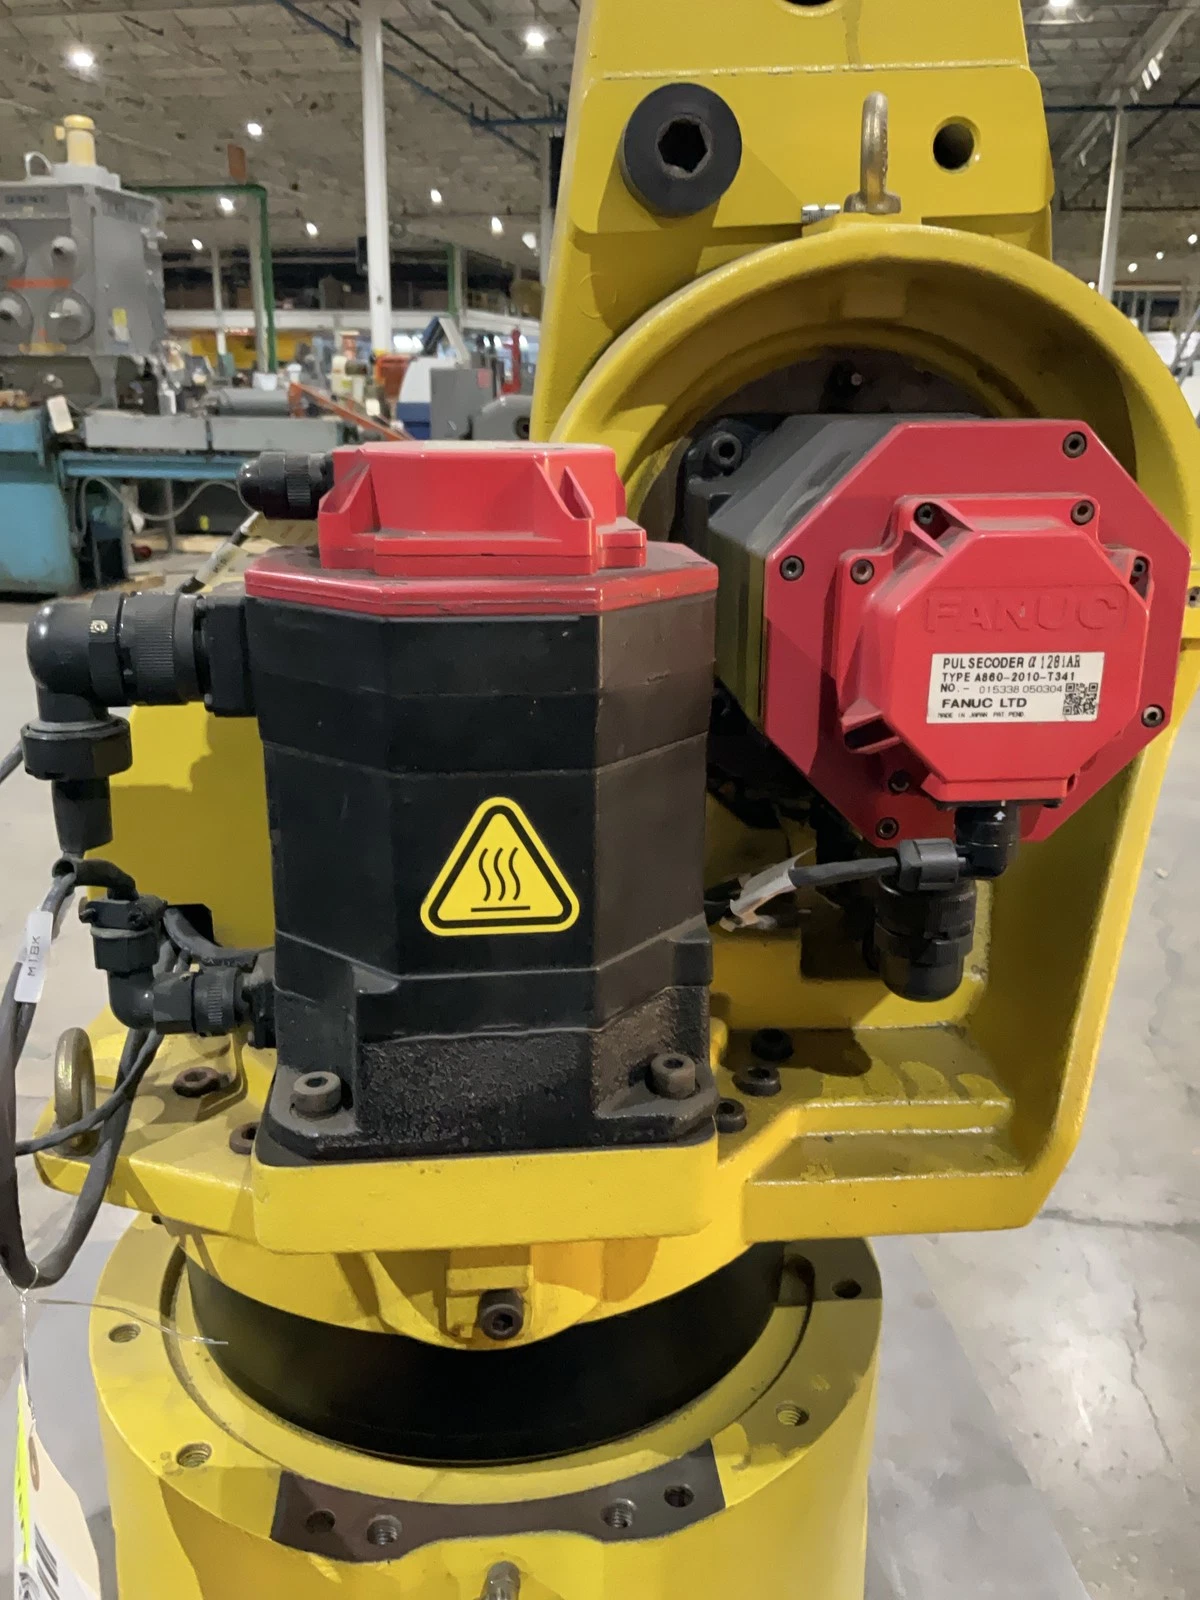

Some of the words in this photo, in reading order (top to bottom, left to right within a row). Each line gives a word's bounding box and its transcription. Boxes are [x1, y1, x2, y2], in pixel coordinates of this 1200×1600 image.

[925, 594, 1118, 632] FANUC
[943, 657, 1024, 669] PULSECODER
[942, 672, 971, 682] TYPE
[975, 672, 1075, 682] A860-2010-T341
[979, 685, 1020, 694] 015338
[1022, 685, 1063, 693] 050304
[942, 698, 994, 709] FANUC
[999, 698, 1028, 708] LTD
